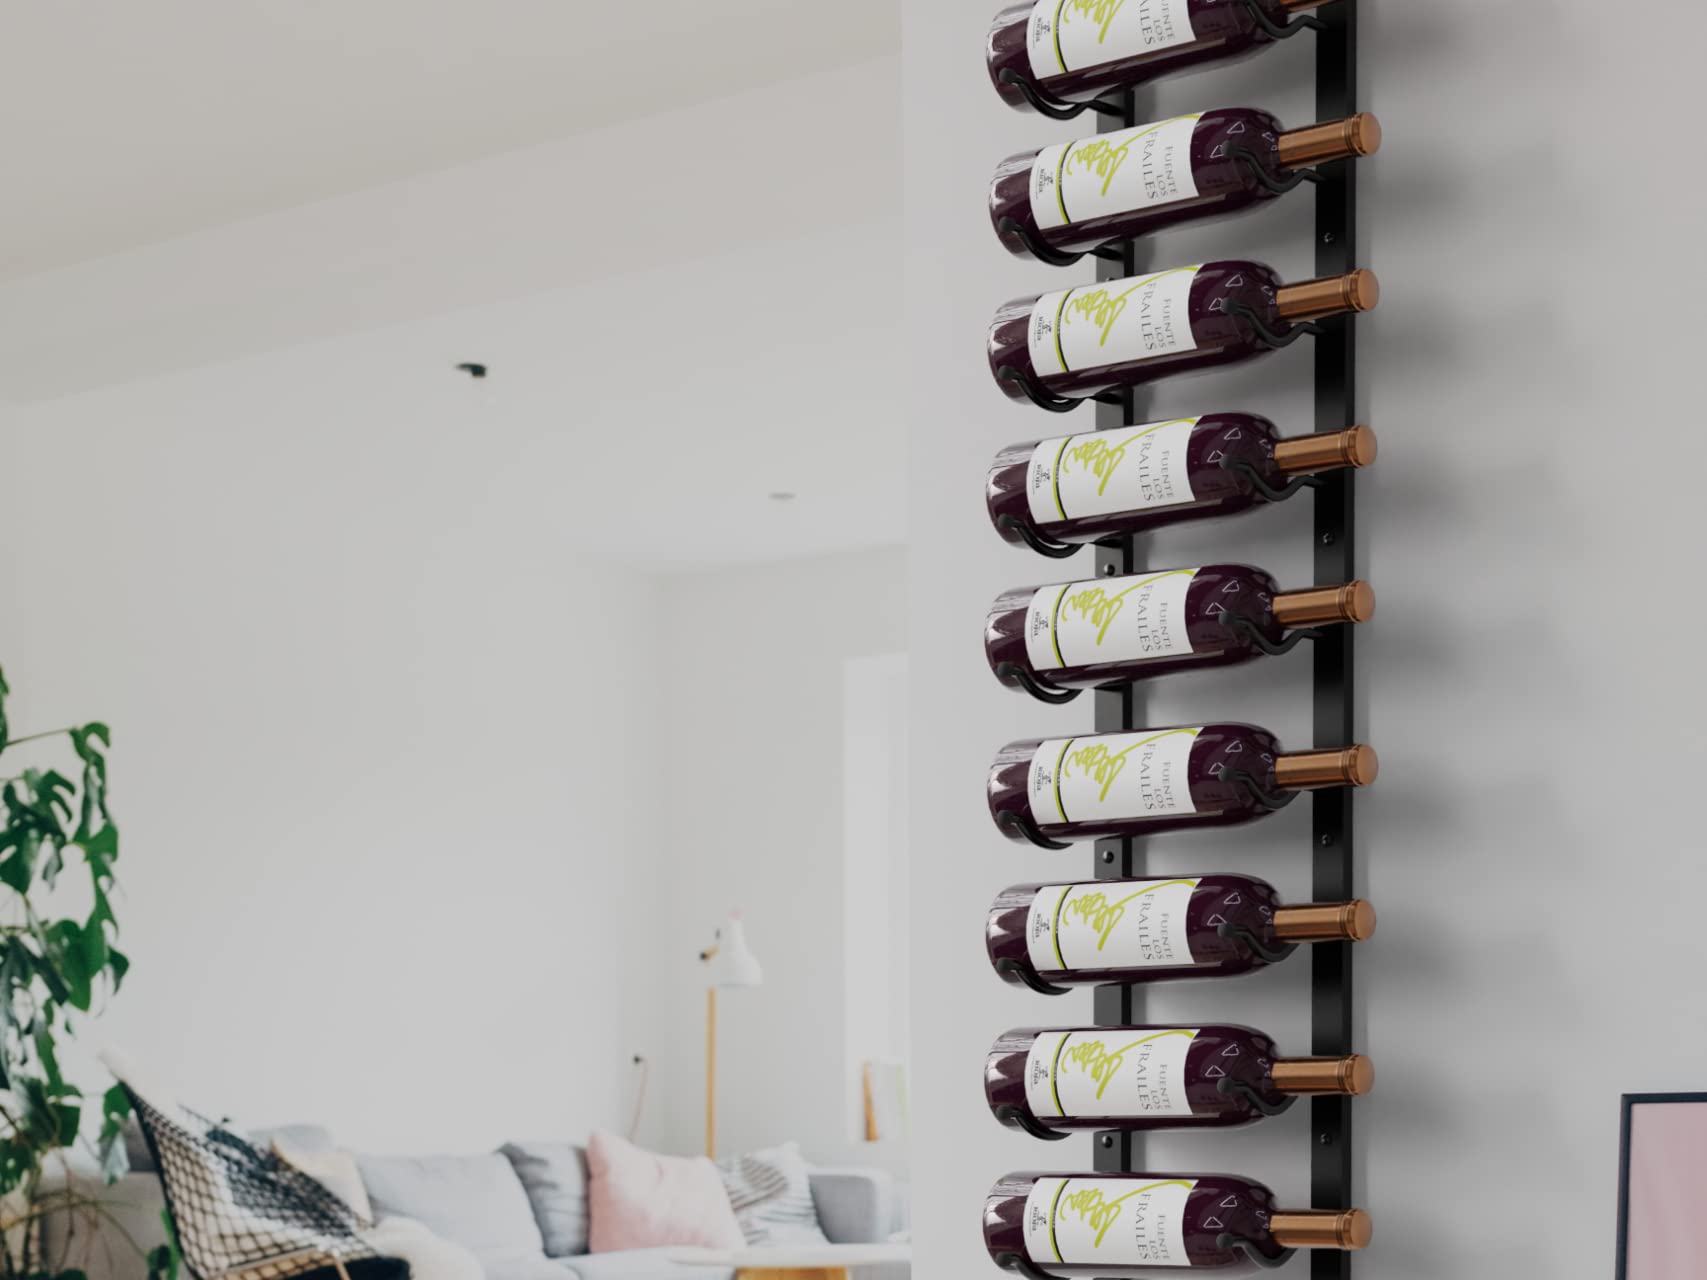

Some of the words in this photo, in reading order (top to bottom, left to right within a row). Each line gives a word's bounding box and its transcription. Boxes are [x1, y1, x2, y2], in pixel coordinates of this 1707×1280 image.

[1154, 20, 1166, 42] LOS
[1143, 131, 1158, 199] FRAILES
[1156, 175, 1168, 197] LOS
[1163, 146, 1177, 194] FUENTE
[1141, 282, 1157, 351] FRAILES
[1155, 327, 1166, 349] LOS
[1163, 298, 1176, 346] FUENTE
[1138, 434, 1154, 502] FRAILES
[1153, 478, 1163, 499] LOS
[1161, 450, 1174, 498] FUENTE
[1137, 585, 1153, 652] FRAILES
[1152, 630, 1162, 651] LOS
[1159, 602, 1172, 649] FUENTE
[1140, 743, 1156, 810] FRAILES
[1155, 788, 1166, 810] LOS
[1162, 761, 1176, 808] FUENTE
[1138, 894, 1154, 961] FRAILES
[1152, 939, 1163, 960] LOS
[1161, 913, 1174, 959] FUENTE
[1136, 1044, 1152, 1111] FRAILES
[1150, 1090, 1162, 1110] LOS
[1160, 1064, 1172, 1109] FUENTE
[1135, 1194, 1151, 1260] FRAILES
[1149, 1240, 1160, 1260] LOS
[1157, 1215, 1170, 1260] FUENTE
